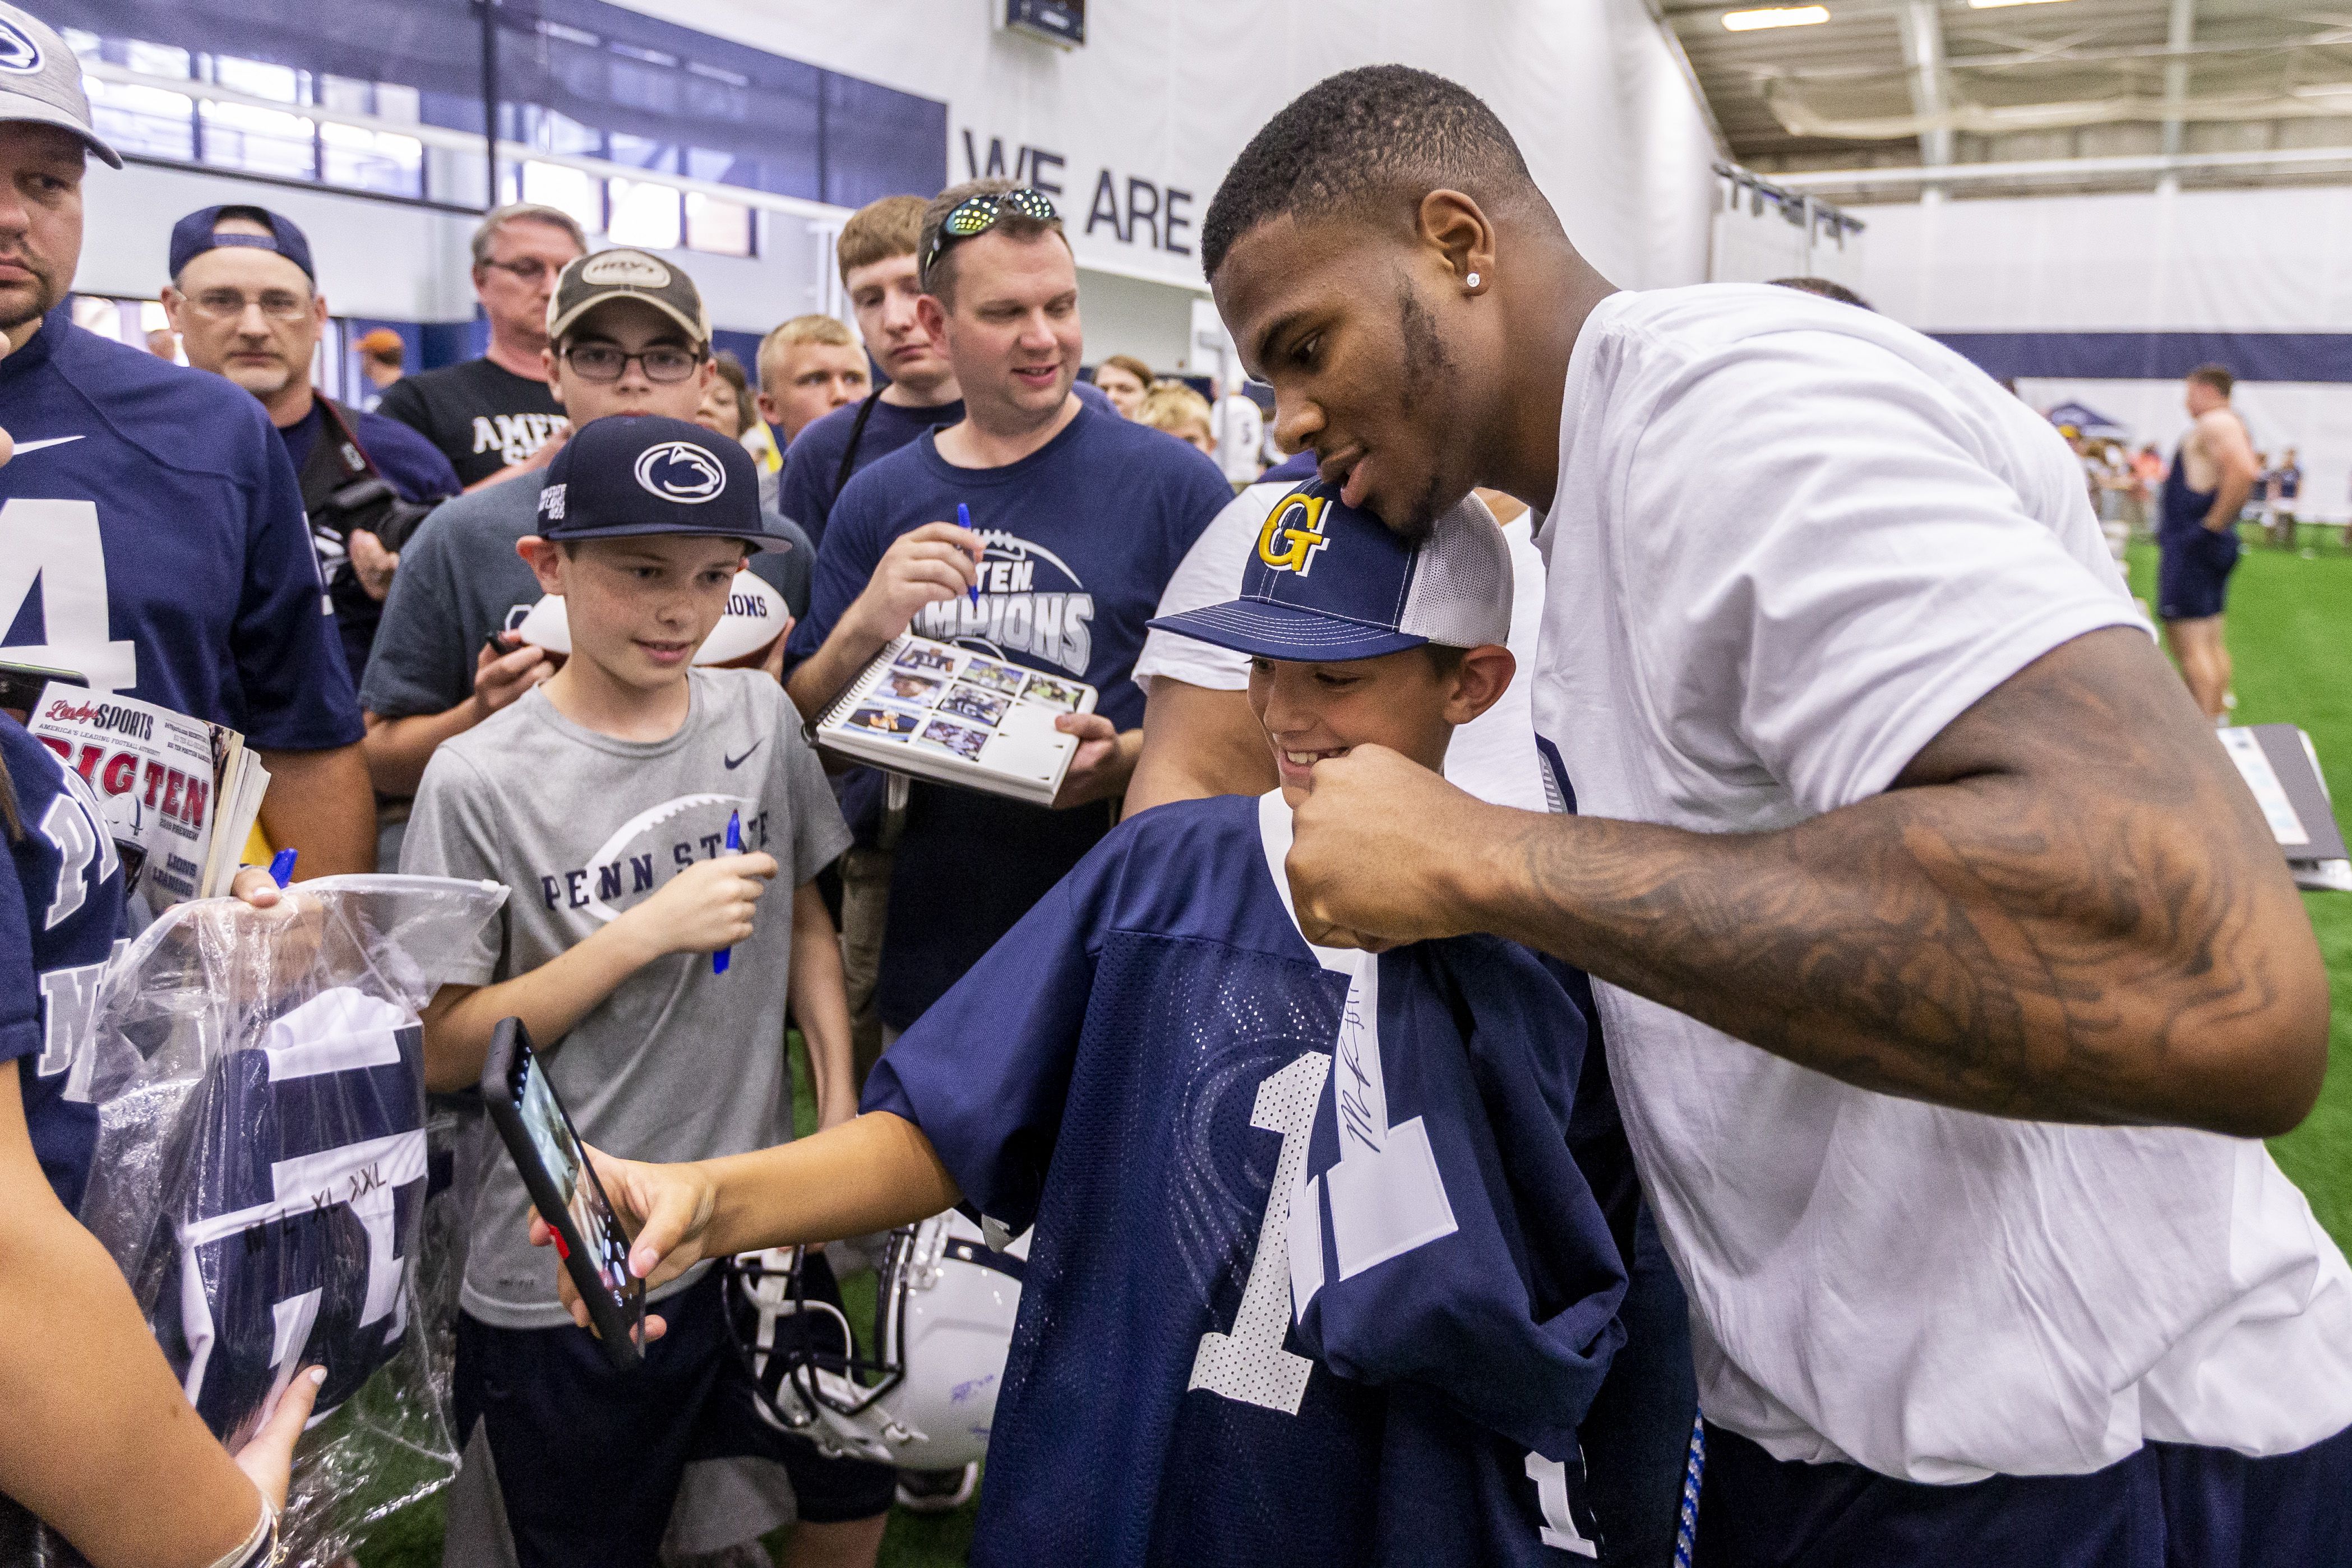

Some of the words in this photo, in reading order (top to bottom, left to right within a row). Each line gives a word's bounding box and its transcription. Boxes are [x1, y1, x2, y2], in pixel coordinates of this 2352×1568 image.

[963, 129, 1065, 196] WE
[1085, 168, 1191, 255] ARE
[1258, 493, 1333, 577] G
[0, 498, 137, 694] 4
[39, 723, 78, 736] AMERICA'S
[80, 730, 110, 743] LEADING
[112, 738, 140, 750] FOOTBALL
[94, 703, 154, 741] SPORTS
[144, 758, 209, 829] TEN
[170, 824, 199, 841] PREVIEW
[167, 852, 197, 877] LIONS
[541, 853, 653, 911] PENN
[312, 1187, 338, 1223] XL
[349, 1162, 387, 1203] XXL
